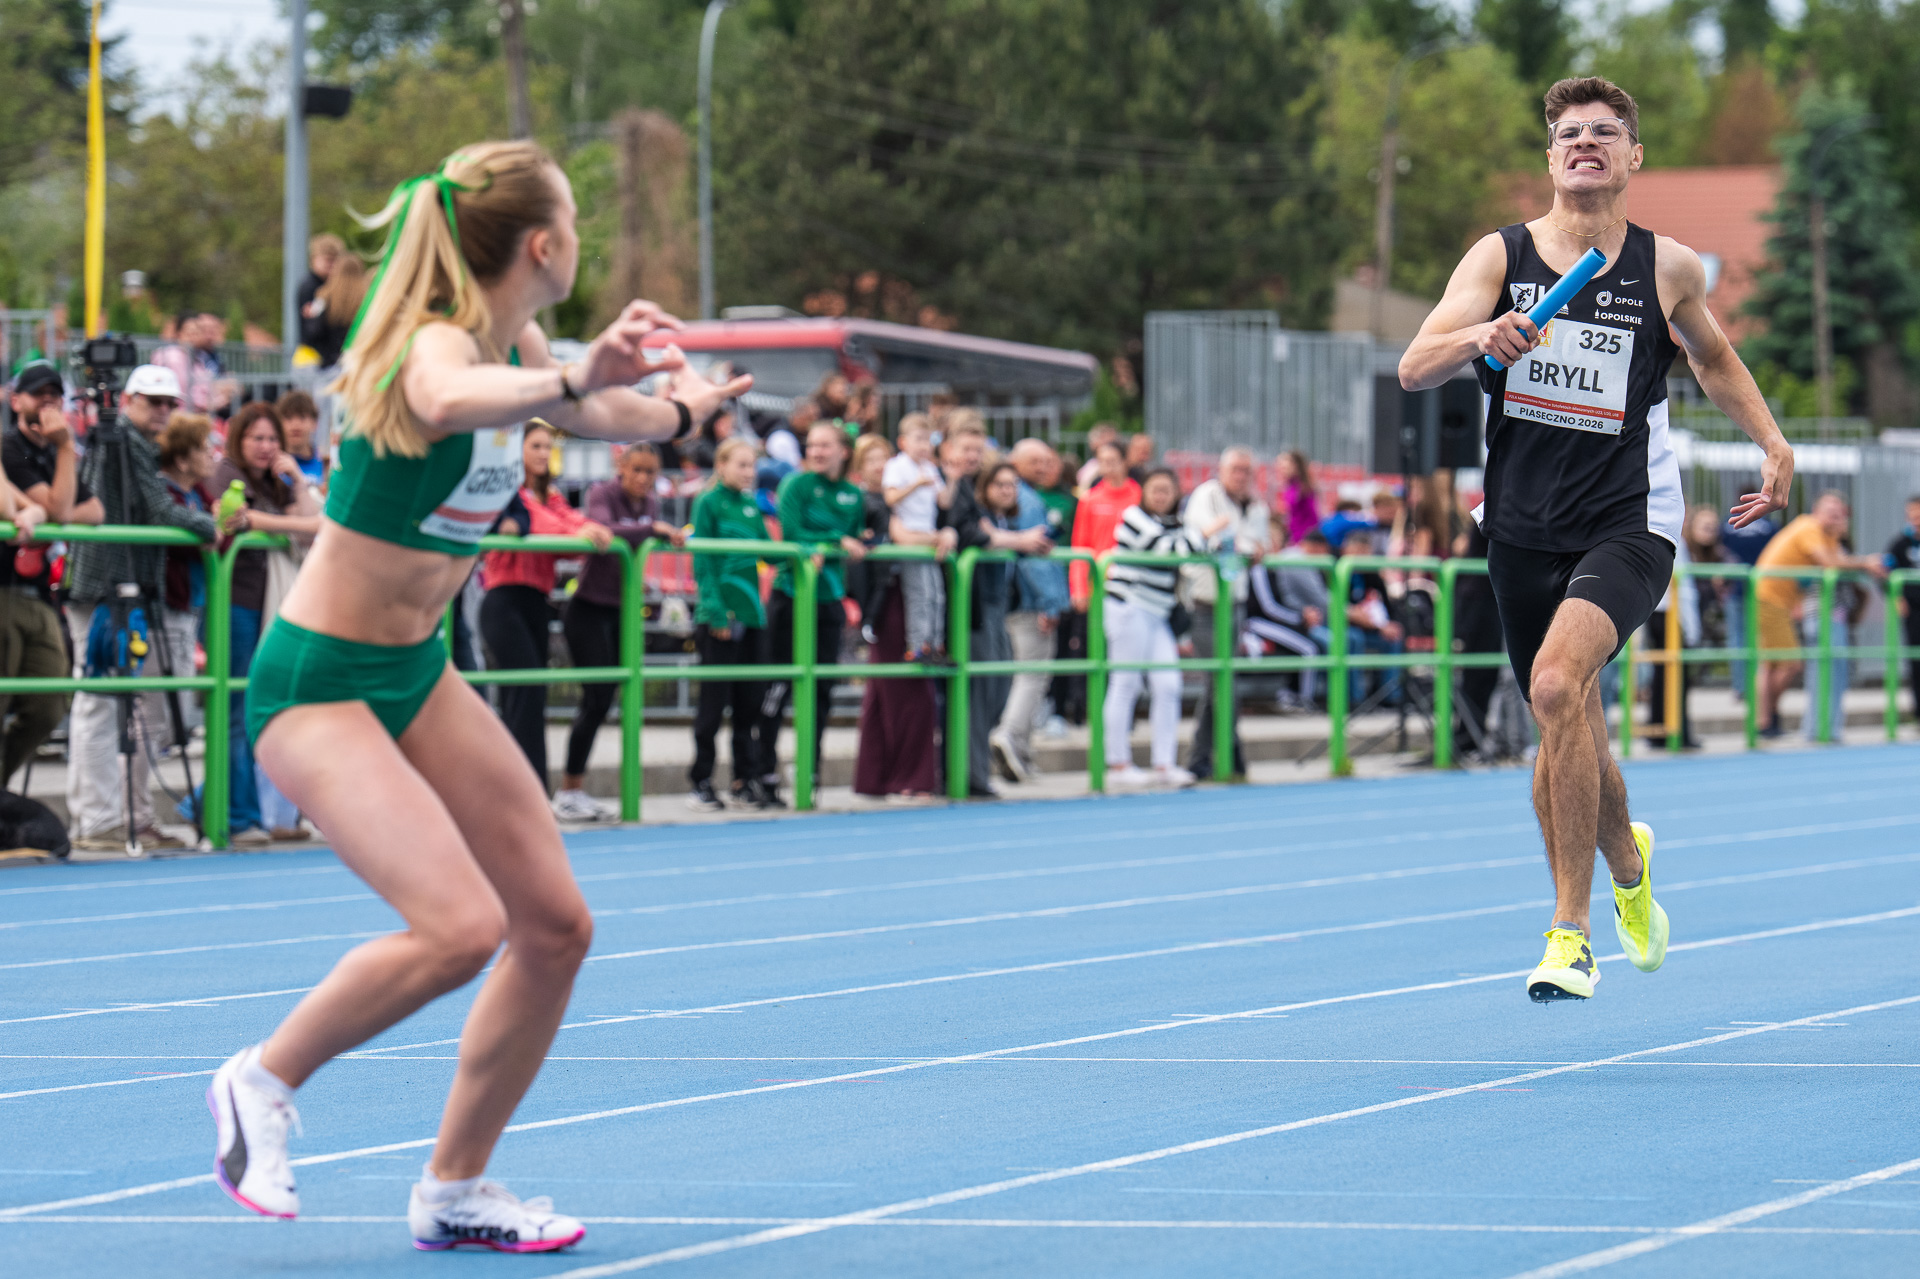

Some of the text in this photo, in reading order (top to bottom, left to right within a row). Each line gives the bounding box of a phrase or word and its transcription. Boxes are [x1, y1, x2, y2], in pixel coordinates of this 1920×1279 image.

[1614, 296, 1644, 307] OPOLE
[1600, 312, 1643, 325] OPOLSKIE
[1578, 329, 1622, 355] 325
[1528, 359, 1604, 394] BRYLL
[1519, 407, 1604, 430] PIASECZNO 2026
